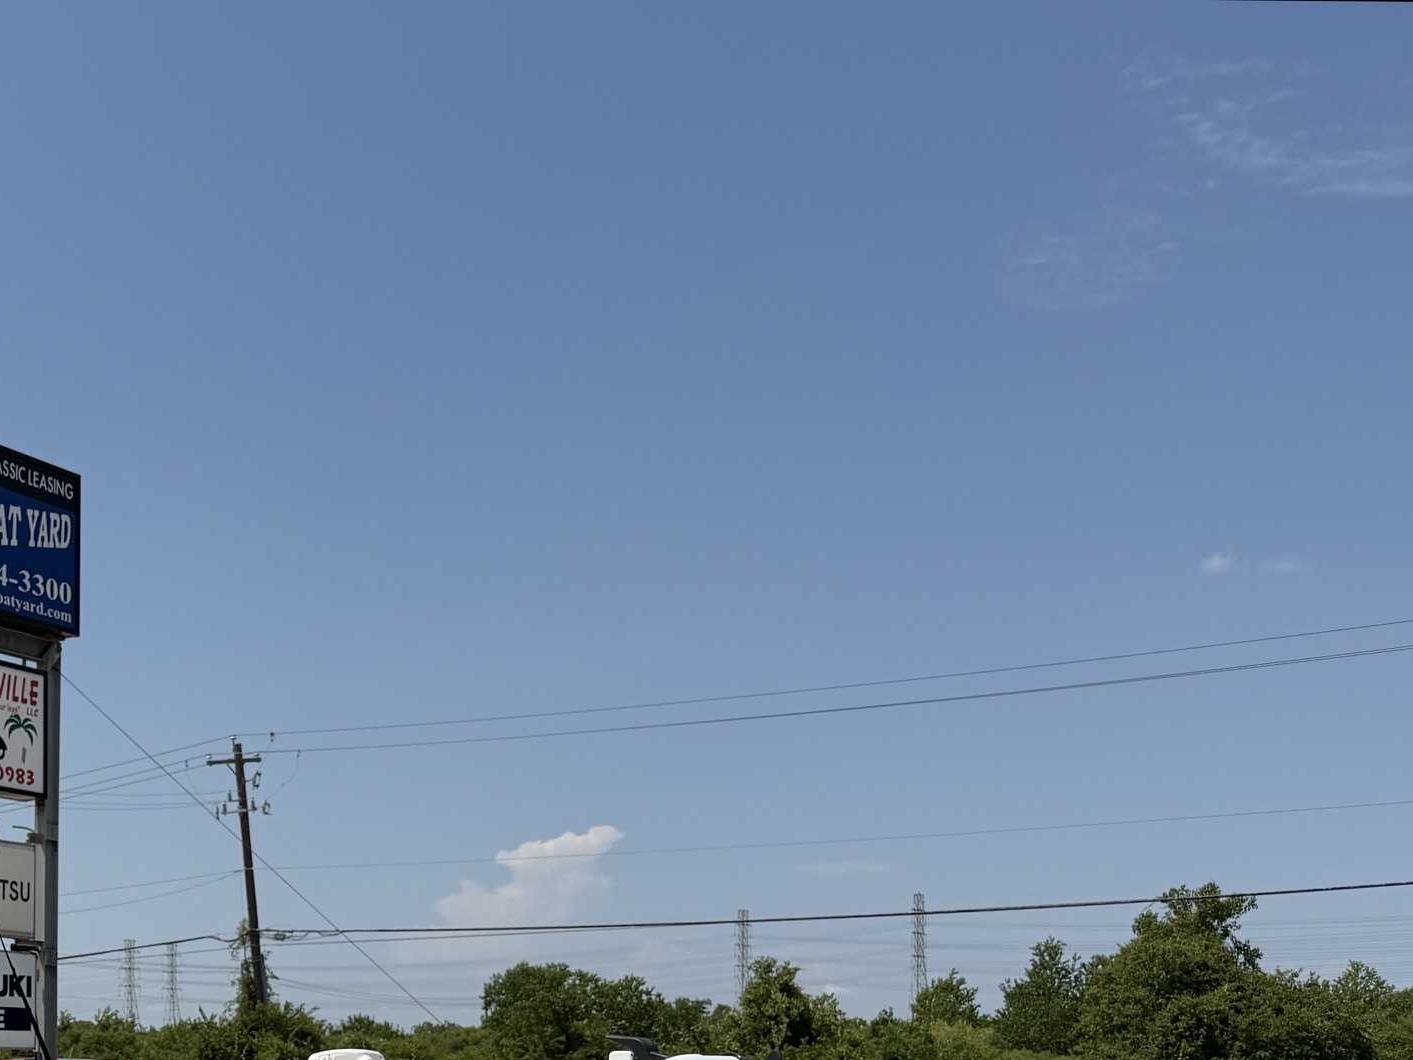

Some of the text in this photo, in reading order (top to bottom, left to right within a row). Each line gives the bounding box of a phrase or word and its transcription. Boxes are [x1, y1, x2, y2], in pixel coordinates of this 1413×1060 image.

[27, 469, 74, 500] LEASING
[26, 508, 72, 549] YARD
[26, 707, 39, 717] LLC
